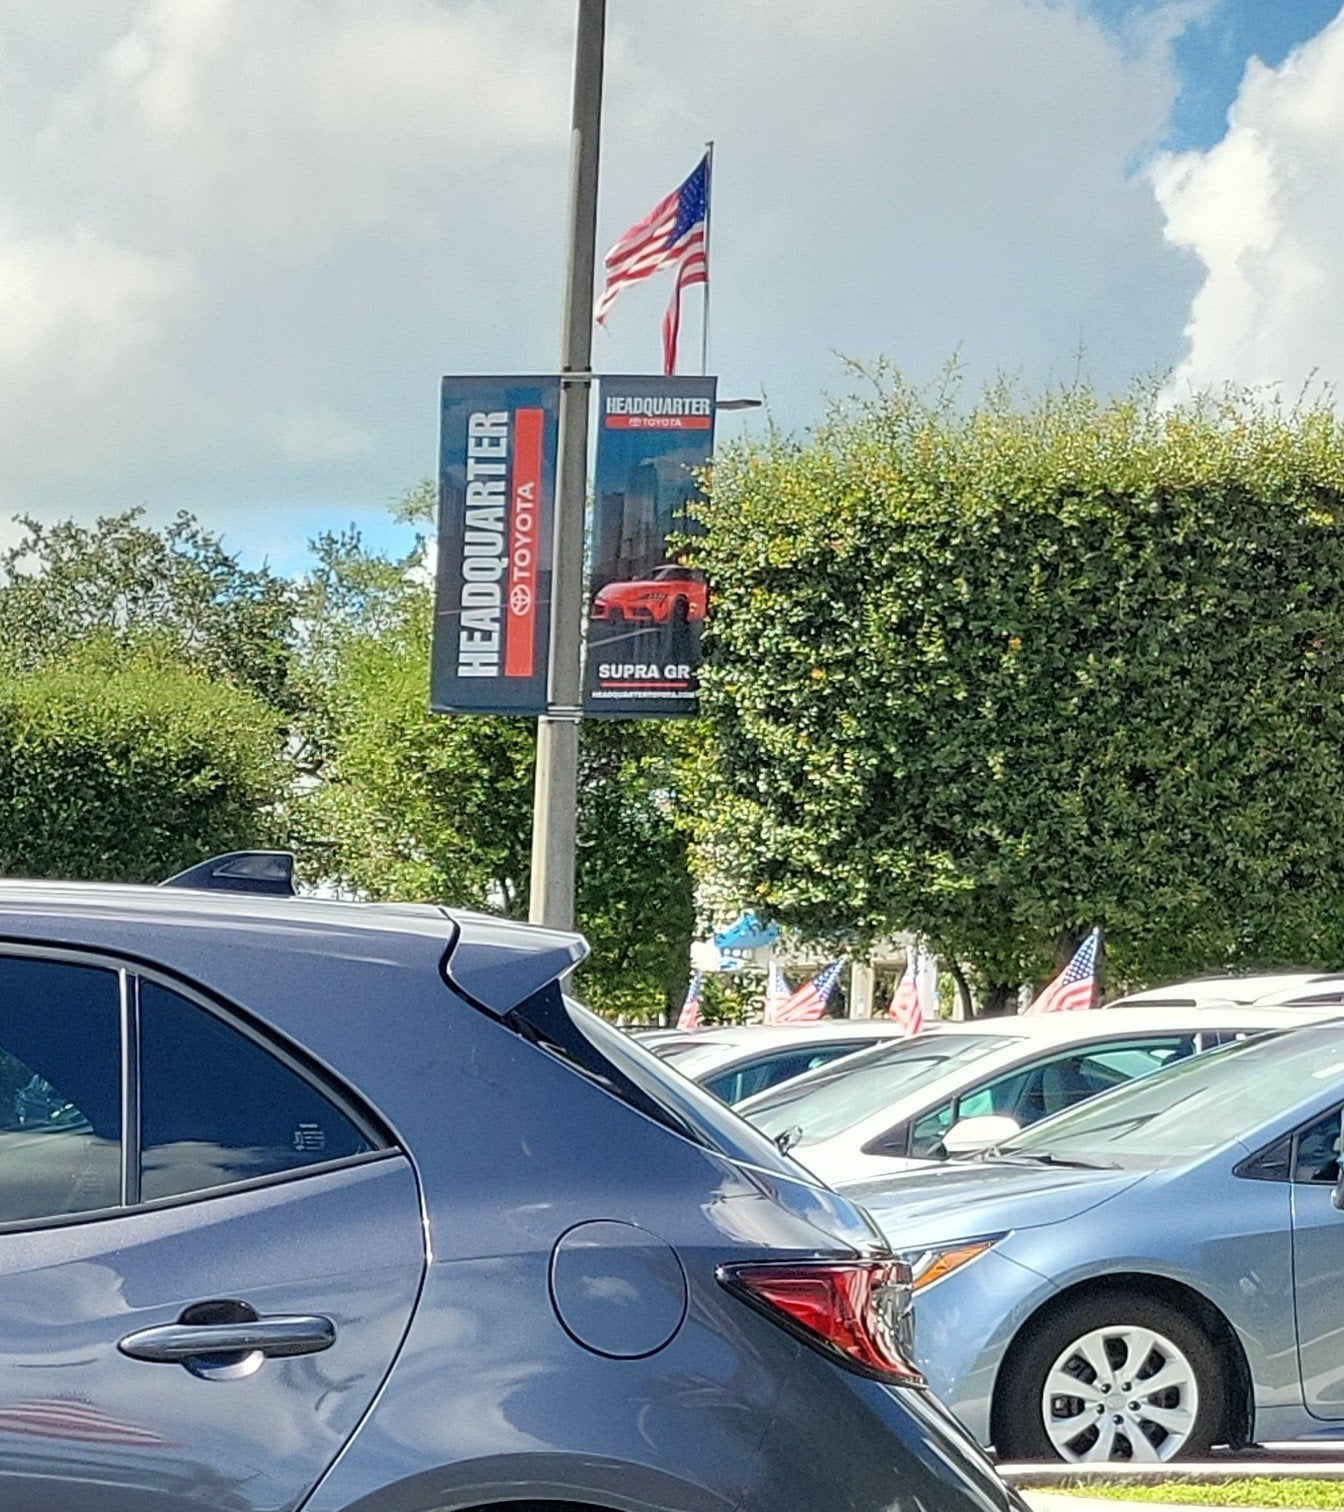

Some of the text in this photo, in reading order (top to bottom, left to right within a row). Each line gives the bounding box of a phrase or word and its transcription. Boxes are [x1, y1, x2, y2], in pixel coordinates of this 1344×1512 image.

[606, 396, 710, 417] HEADQUARTER
[643, 417, 683, 428] TOYOTA
[512, 481, 534, 581] TOYOTA
[457, 410, 509, 678] HEADQUARTER
[598, 663, 690, 679] SUPRA GR
